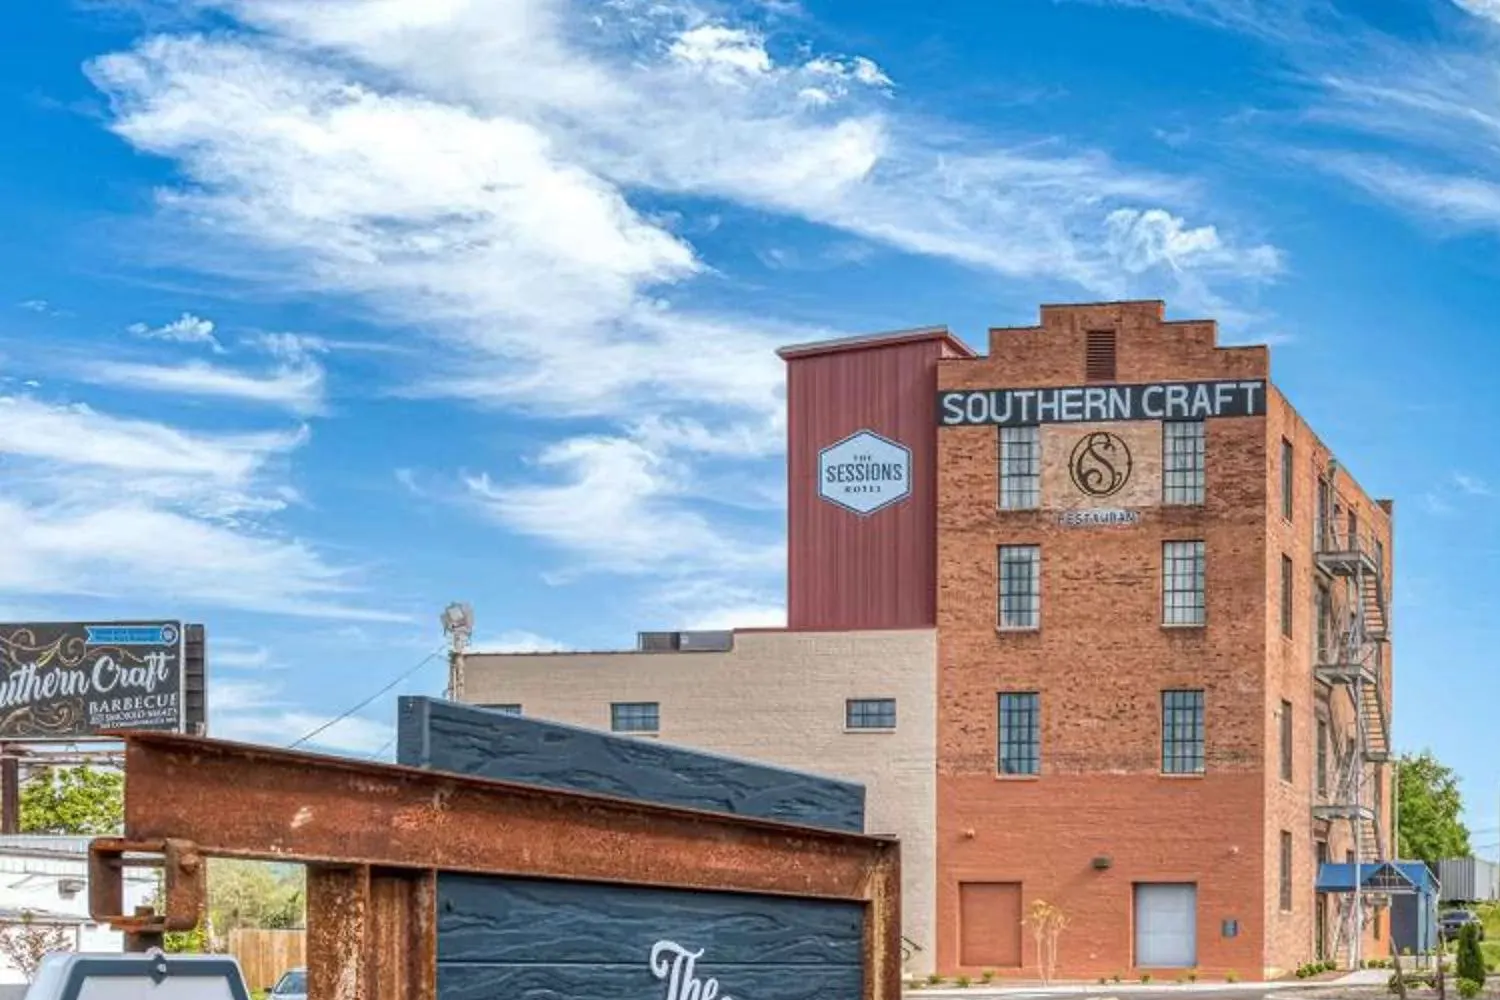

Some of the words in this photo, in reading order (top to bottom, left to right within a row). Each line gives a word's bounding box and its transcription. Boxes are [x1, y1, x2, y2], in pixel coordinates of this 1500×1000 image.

[942, 387, 1130, 425] SOUTHERN
[1142, 381, 1264, 418] CRAFT
[826, 463, 903, 483] SESSIONS
[92, 652, 175, 692] Craft
[89, 692, 178, 714] BARBECUE
